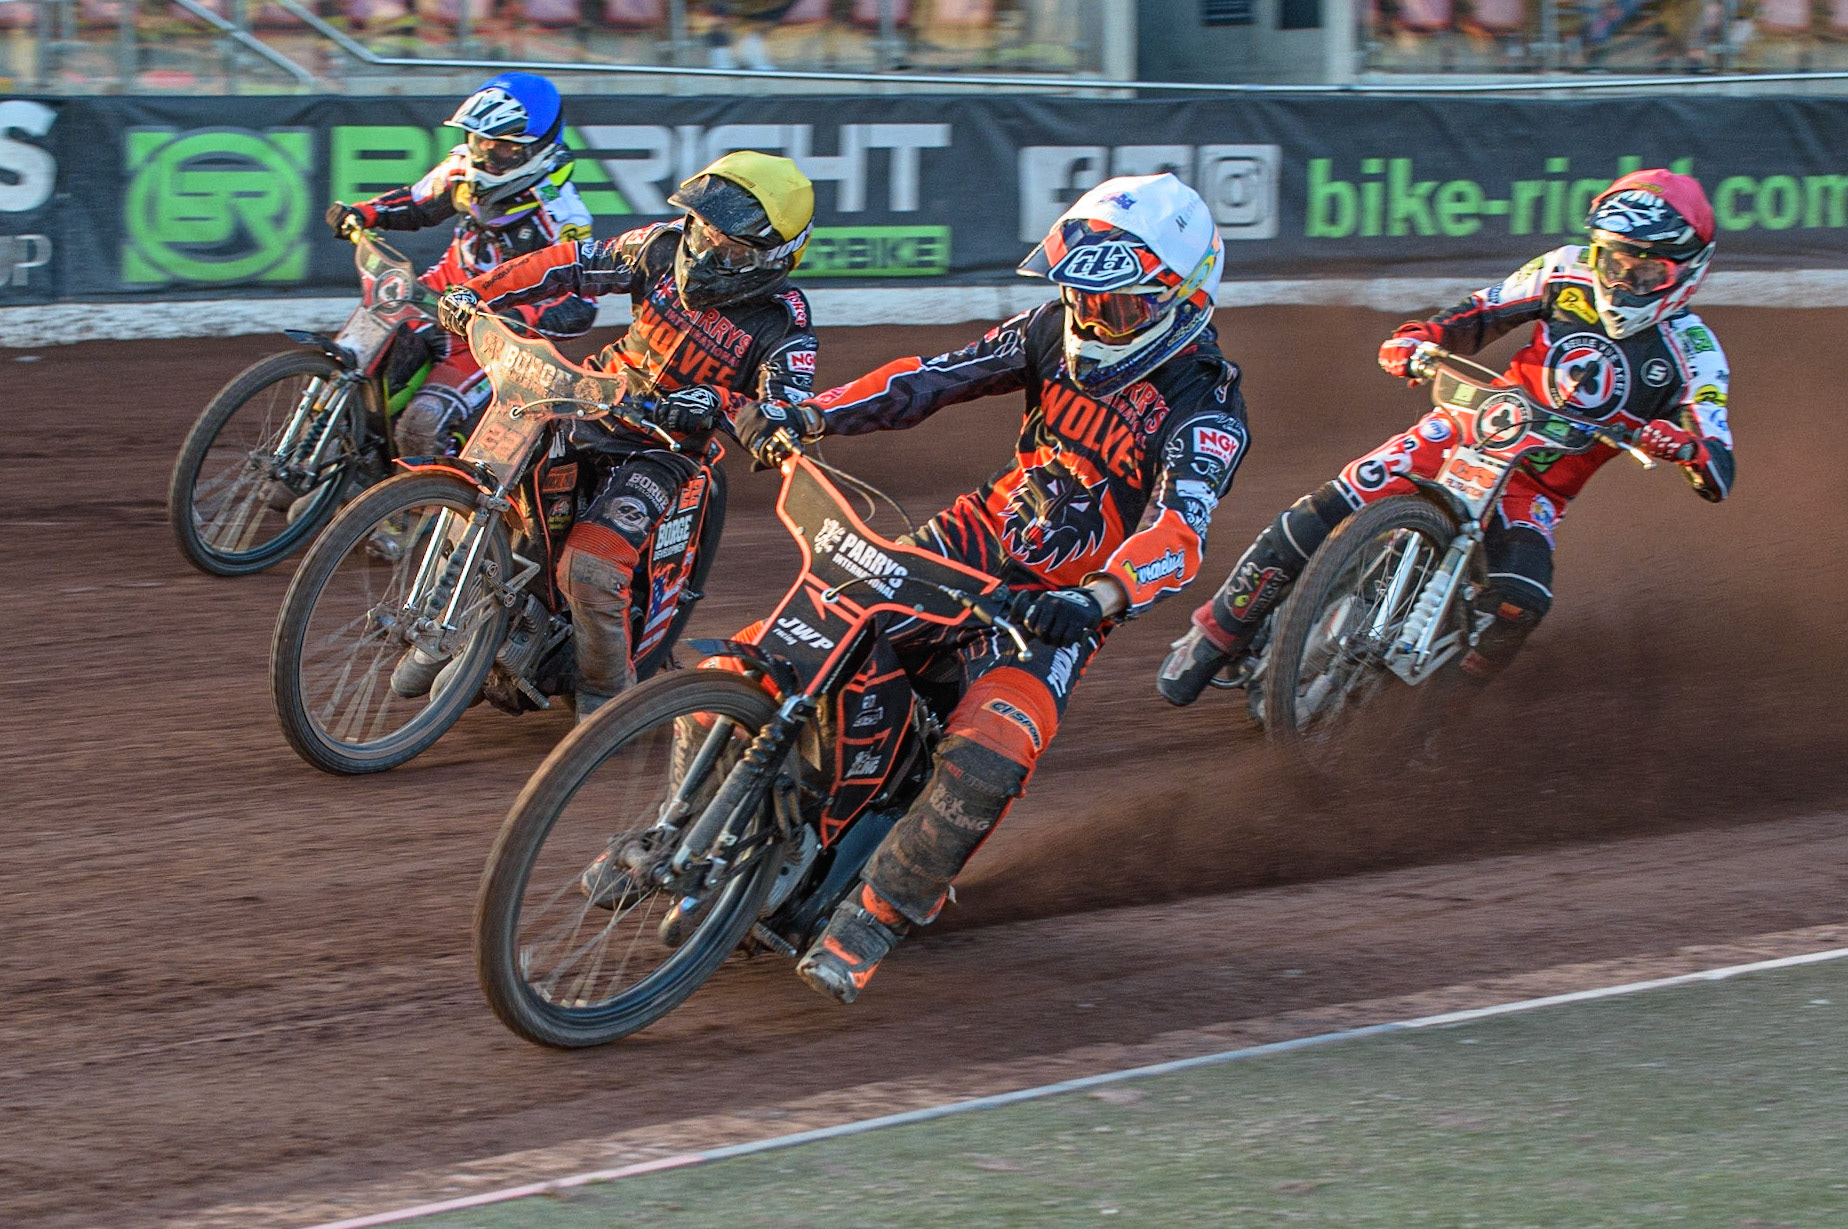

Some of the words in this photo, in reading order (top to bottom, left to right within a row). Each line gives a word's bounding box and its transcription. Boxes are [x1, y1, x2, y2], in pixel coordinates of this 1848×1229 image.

[1306, 157, 1848, 244] bike-rigcom
[1040, 378, 1145, 490] WOLVES
[628, 472, 669, 511] BORGE
[655, 514, 693, 551] BORGE
[838, 533, 909, 589] PARRYS
[777, 616, 835, 650] JWP
